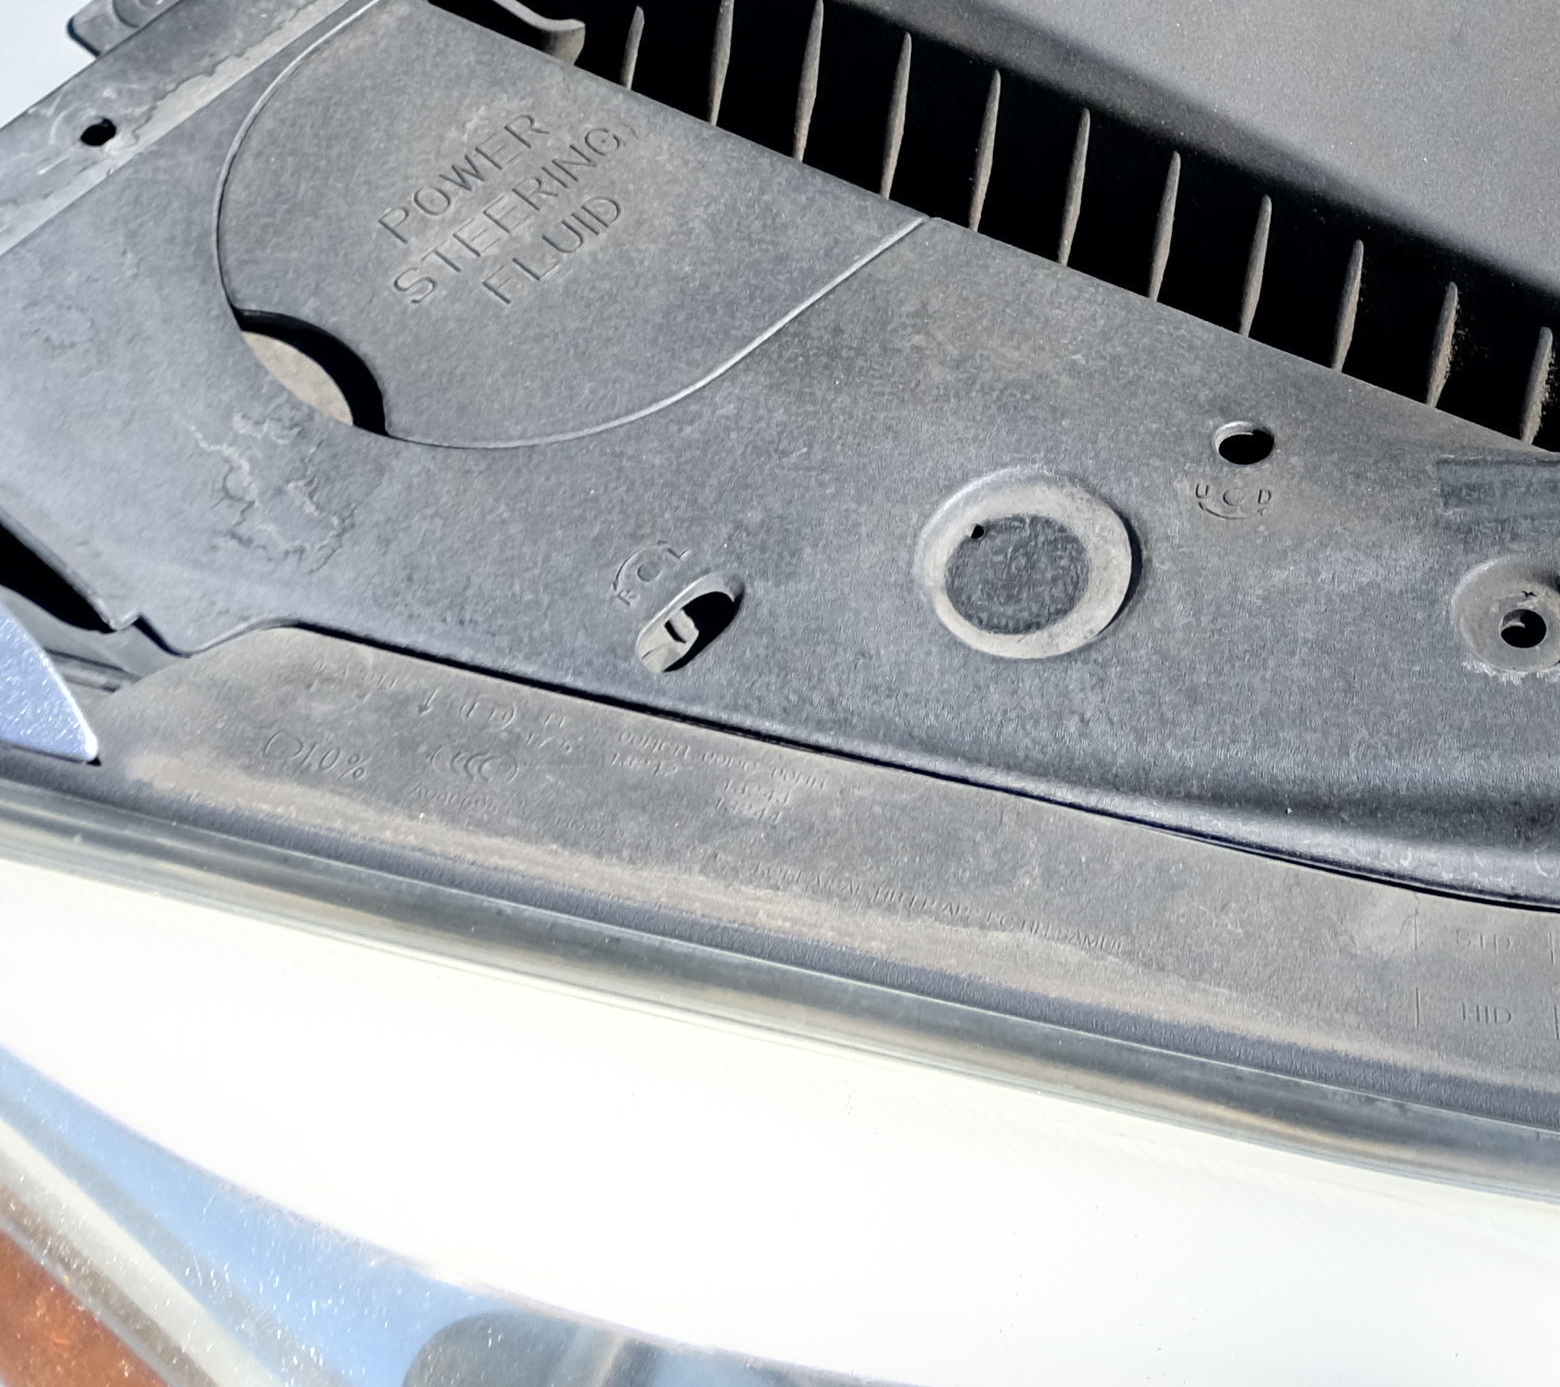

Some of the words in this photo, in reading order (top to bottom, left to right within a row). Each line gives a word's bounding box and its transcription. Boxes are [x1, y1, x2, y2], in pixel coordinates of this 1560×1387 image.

[378, 113, 551, 246] POWER
[392, 126, 623, 305] STEERING
[483, 193, 623, 307] FLUID
[1461, 1001, 1513, 1025] HID
